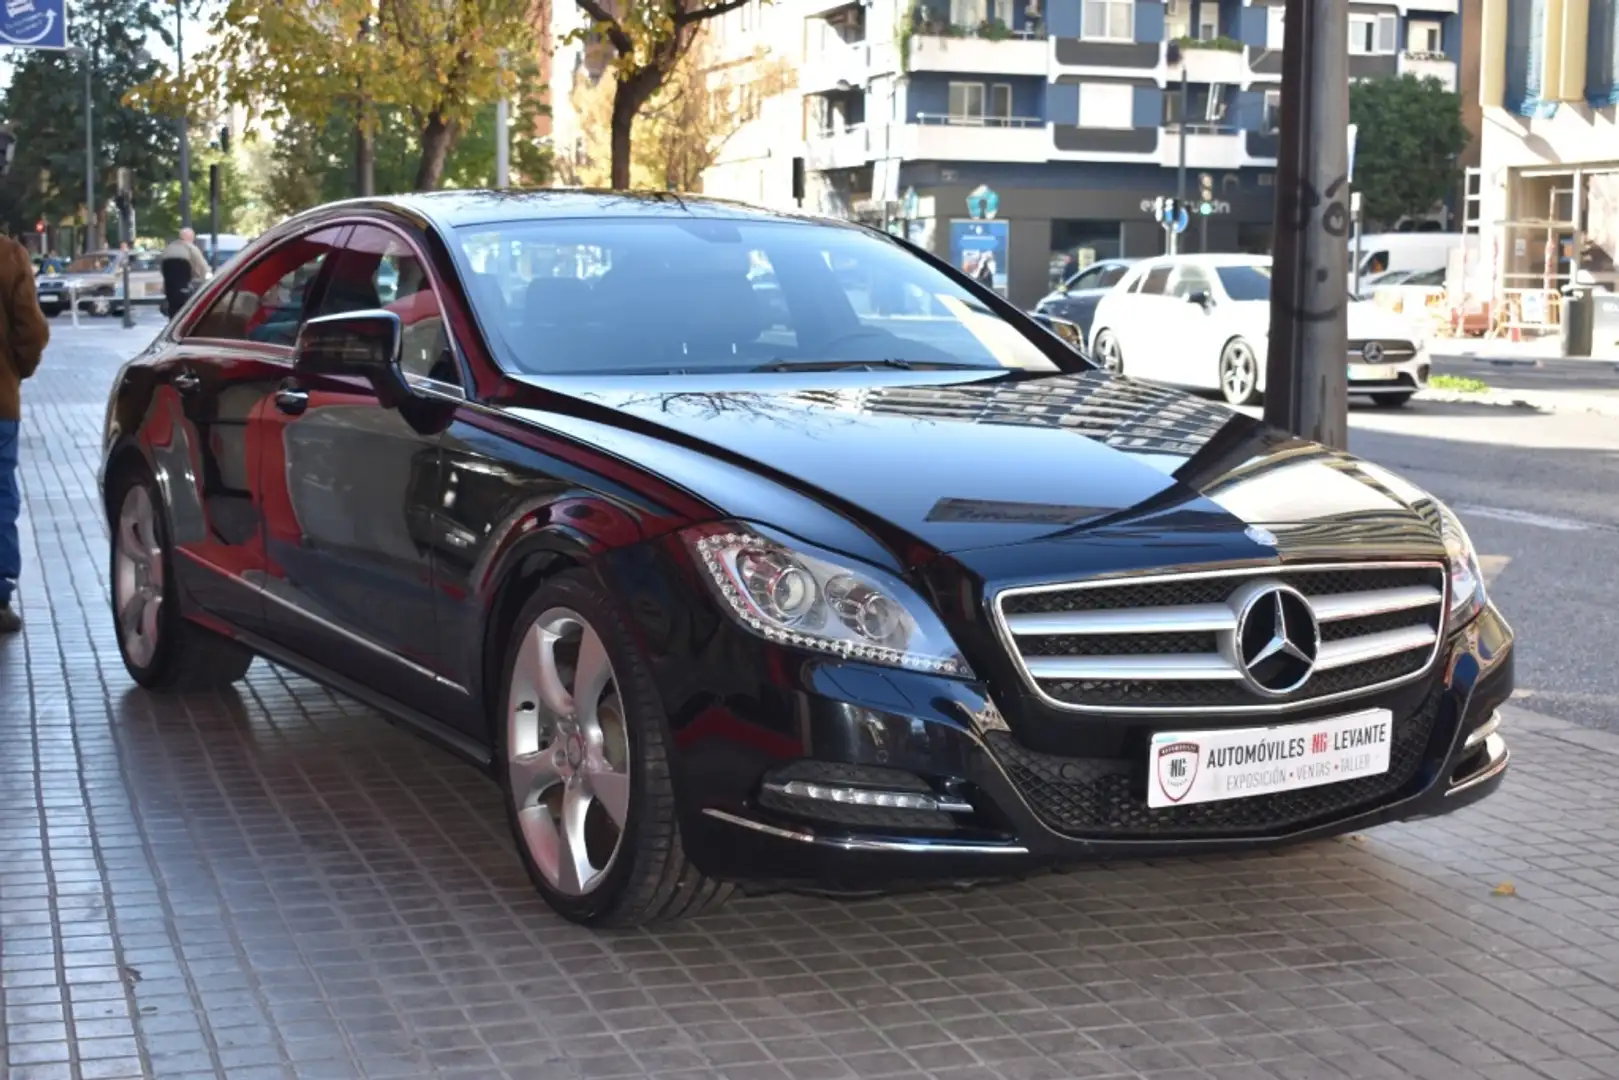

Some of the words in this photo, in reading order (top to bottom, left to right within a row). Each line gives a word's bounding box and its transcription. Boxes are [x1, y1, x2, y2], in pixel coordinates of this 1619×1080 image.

[1206, 737, 1305, 769] AUTOMÓVILES
[1311, 731, 1328, 754] NG
[1333, 722, 1387, 751] LEVANTE
[1226, 768, 1286, 791] EXPOSICIÓN
[1296, 760, 1331, 780] VENTAS
[1340, 753, 1371, 773] TALLER
